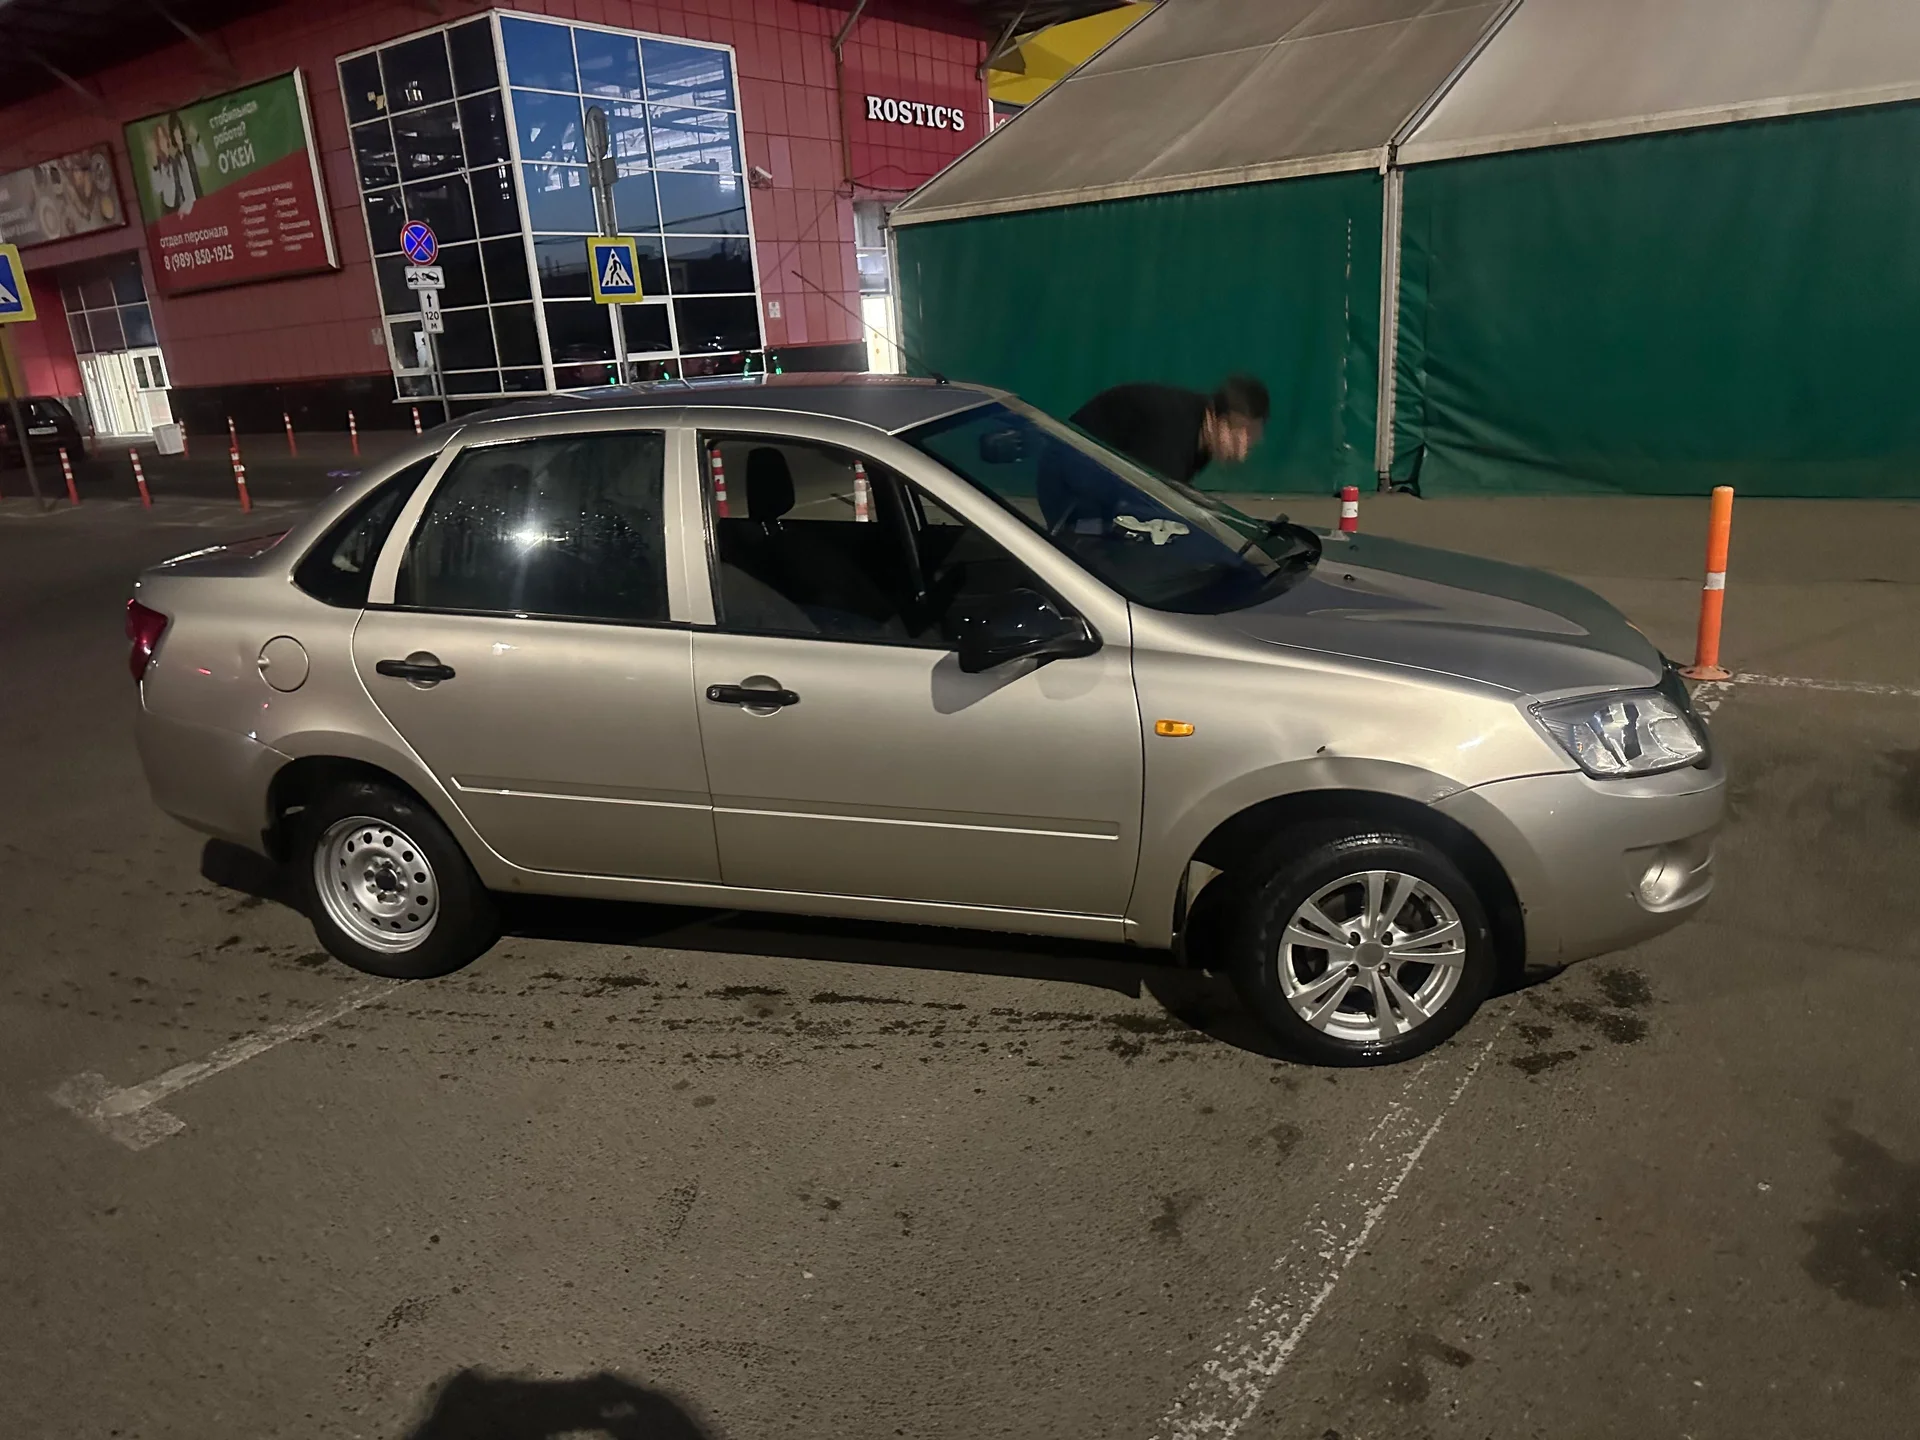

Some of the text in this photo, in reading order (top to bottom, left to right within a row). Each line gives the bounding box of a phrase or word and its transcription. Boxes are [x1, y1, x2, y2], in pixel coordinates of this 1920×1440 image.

[867, 96, 965, 131] ROSTIC'S
[160, 234, 184, 248] отдел
[184, 225, 228, 245] персонала
[164, 255, 171, 271] 8
[171, 251, 195, 272] (989)
[194, 243, 234, 265] 850-1925
[425, 311, 439, 320] 120
